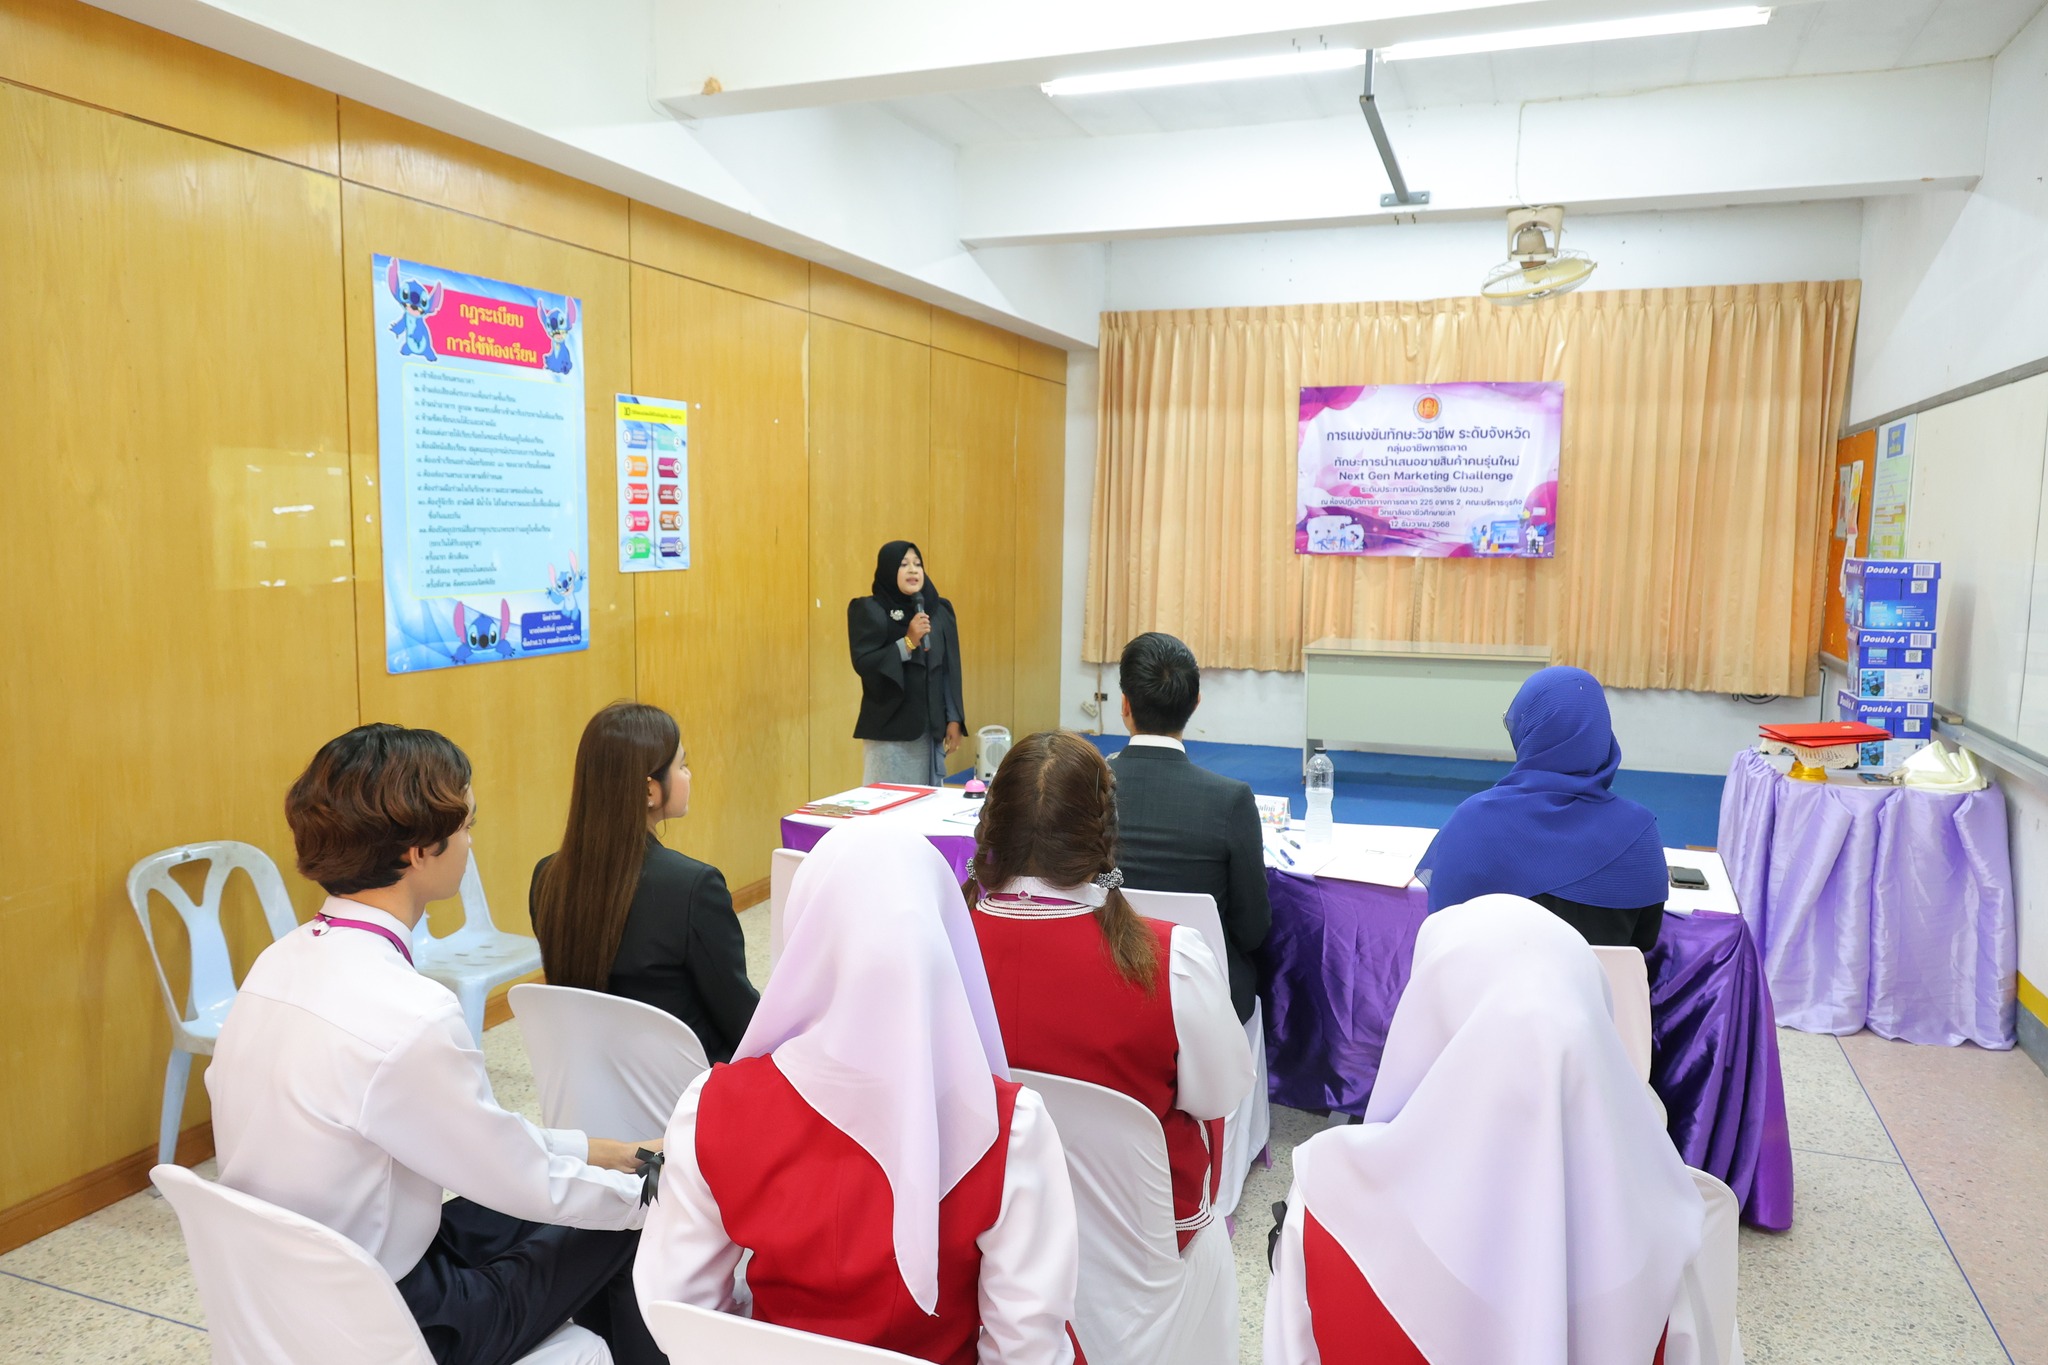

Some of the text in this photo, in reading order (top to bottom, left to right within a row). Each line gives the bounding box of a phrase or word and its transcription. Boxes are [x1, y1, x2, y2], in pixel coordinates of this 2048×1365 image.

[459, 303, 524, 328] กฎระเบียบ
[446, 331, 538, 363] การใช้ห้องเรียน
[1326, 426, 1531, 441] การแข่งขันทักษะวิชาชีพ ระดับจังหวัด
[1387, 443, 1468, 455] กลุ่มอาชีพการตลาด
[1334, 455, 1520, 469] ทักษะการนำเสนอขายสินค้าคนรุ่นใหม่
[1339, 470, 1514, 483] Next Gen Marketing Challenge
[1420, 498, 1434, 506] 225
[1456, 498, 1461, 506] 2
[1432, 520, 1450, 528] 2568
[1866, 565, 1908, 574] Double A
[1862, 635, 1905, 644] Double A
[1860, 704, 1902, 713] Double A
